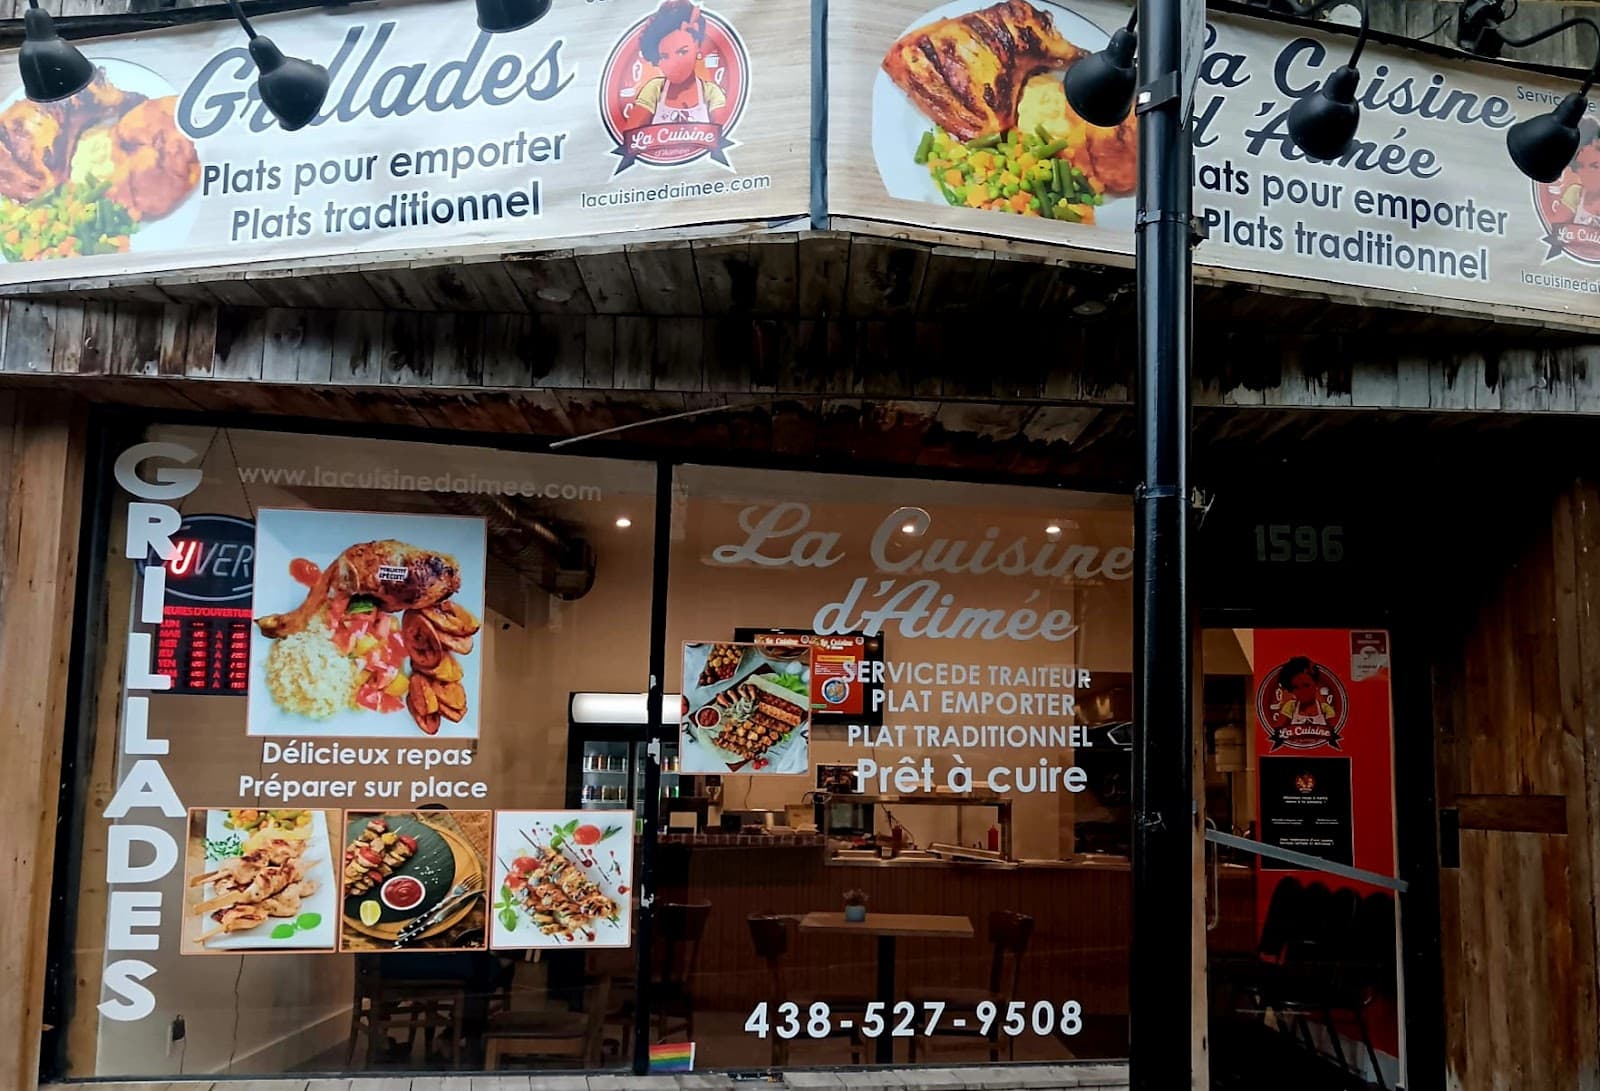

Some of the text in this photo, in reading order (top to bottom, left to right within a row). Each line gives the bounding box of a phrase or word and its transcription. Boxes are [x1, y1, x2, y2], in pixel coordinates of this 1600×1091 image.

[178, 21, 575, 139] Grllades
[1198, 23, 1250, 87] a
[1274, 37, 1516, 128] Cisine
[1517, 86, 1561, 105] Servic
[631, 127, 716, 149] La Cuisine
[1245, 101, 1443, 179] 'Amée
[203, 131, 567, 196] Plats pour emporter
[582, 175, 770, 208] lacuisinedaimee.com
[1192, 154, 1508, 236] lats pour emporter
[232, 182, 540, 241] Plats traditionnel
[1204, 208, 1488, 281] Plats traditionnel
[1577, 228, 1600, 245] Cui
[238, 466, 602, 502] www.lacuisinedaimee.com
[171, 541, 254, 578] UVER
[712, 502, 1134, 580] La Cuisine
[1255, 525, 1344, 563] 1596
[812, 576, 1079, 642] d'Aimée
[988, 665, 1091, 689] TRAITEUR
[872, 689, 1075, 716] PLAT EMPORTER
[97, 441, 203, 1022] GRILLADES
[848, 725, 1093, 749] PLAT TRADITIONNEL
[1295, 727, 1331, 738] Cuisine
[263, 740, 473, 770] Délicieux repas
[239, 773, 488, 802] Préparer sur place
[856, 755, 1087, 794] Prêt à cuire
[744, 1000, 1083, 1039] 438-527-9508
